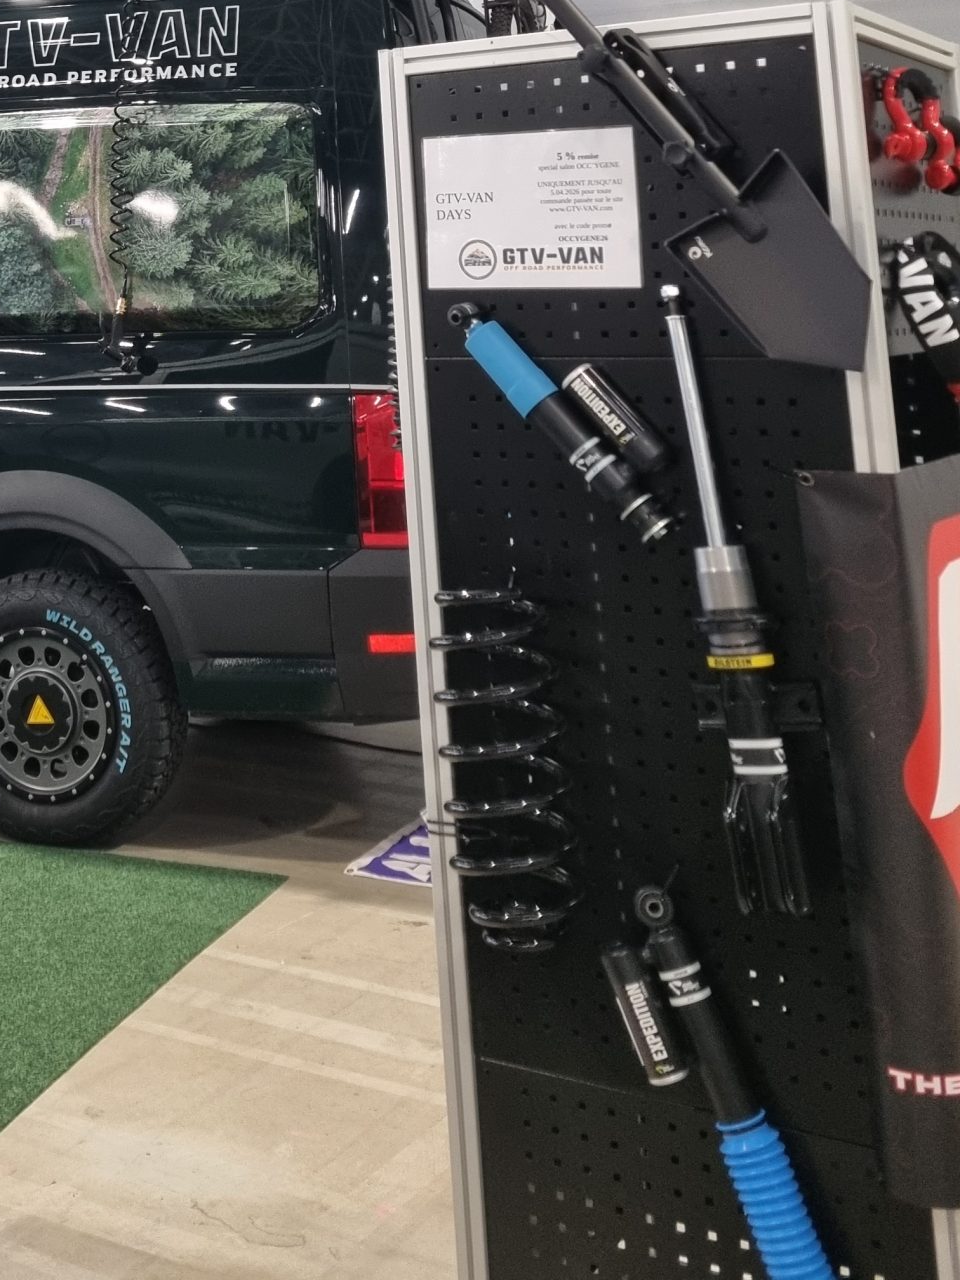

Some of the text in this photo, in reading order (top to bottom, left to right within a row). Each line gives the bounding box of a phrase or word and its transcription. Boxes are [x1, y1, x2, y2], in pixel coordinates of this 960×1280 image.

[67, 62, 239, 84] PERFORMANCE
[435, 192, 494, 205] GTV-VAN
[436, 208, 472, 221] DAYS
[502, 246, 604, 265] GTV-VAN
[570, 377, 627, 436] EXPEDITION
[46, 609, 93, 643] WILD
[90, 637, 132, 729] RANGER
[624, 982, 669, 1062] EXPEDITION
